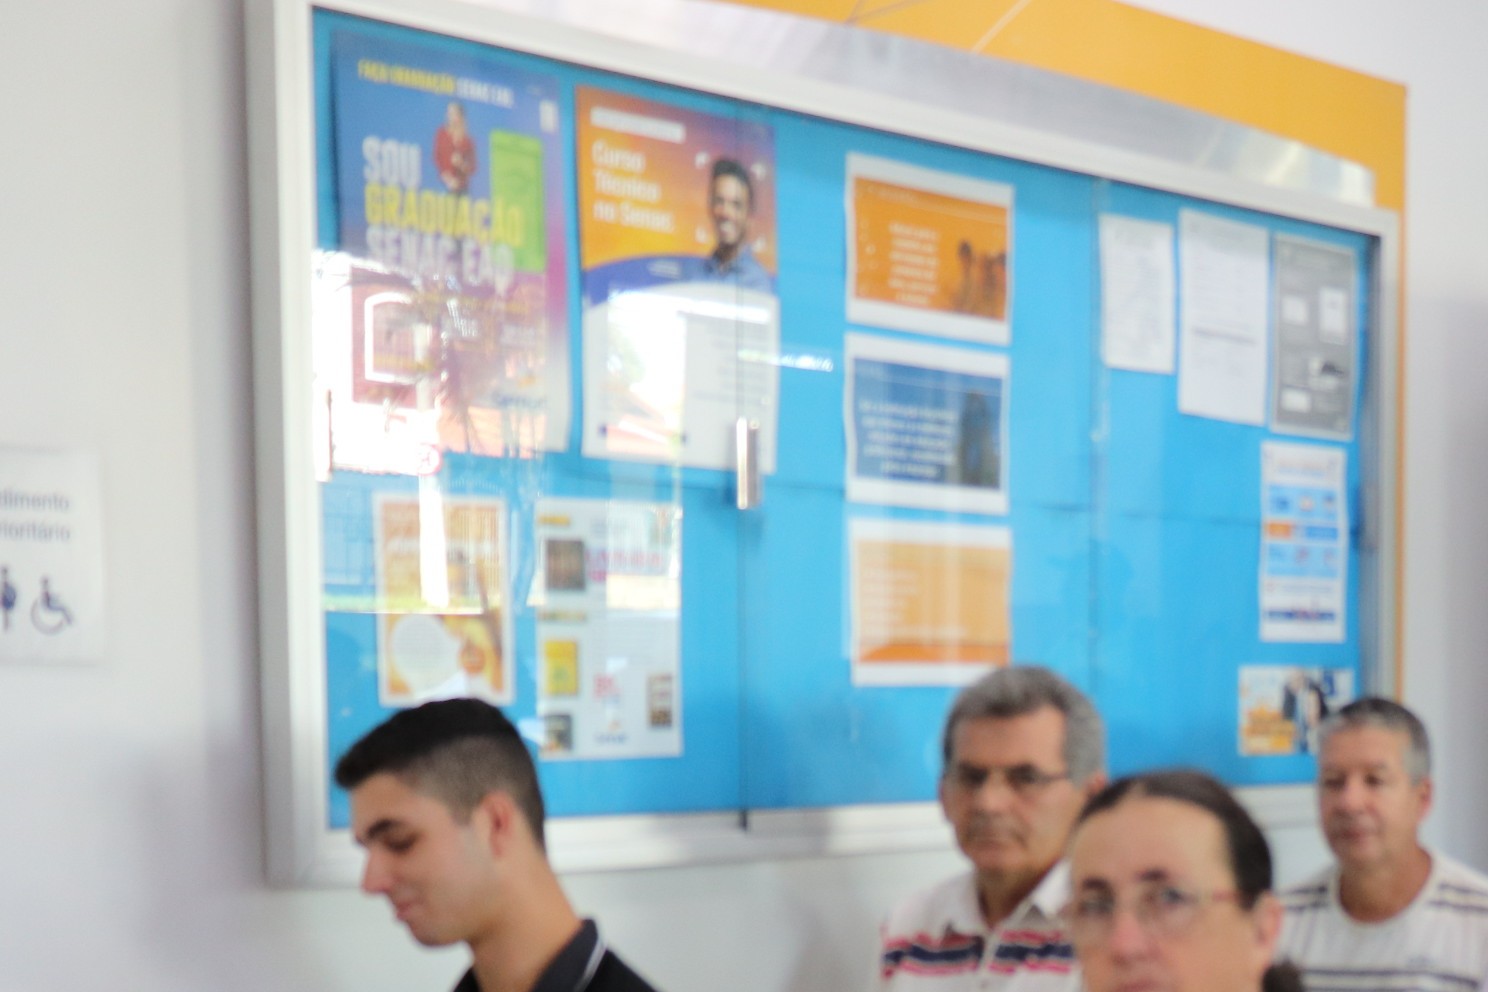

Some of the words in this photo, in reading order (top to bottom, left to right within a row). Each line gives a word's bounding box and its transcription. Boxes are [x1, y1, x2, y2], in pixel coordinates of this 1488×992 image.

[362, 135, 421, 188] SOU
[591, 138, 646, 174] Curso
[364, 182, 525, 248] GRADUAÇÃO
